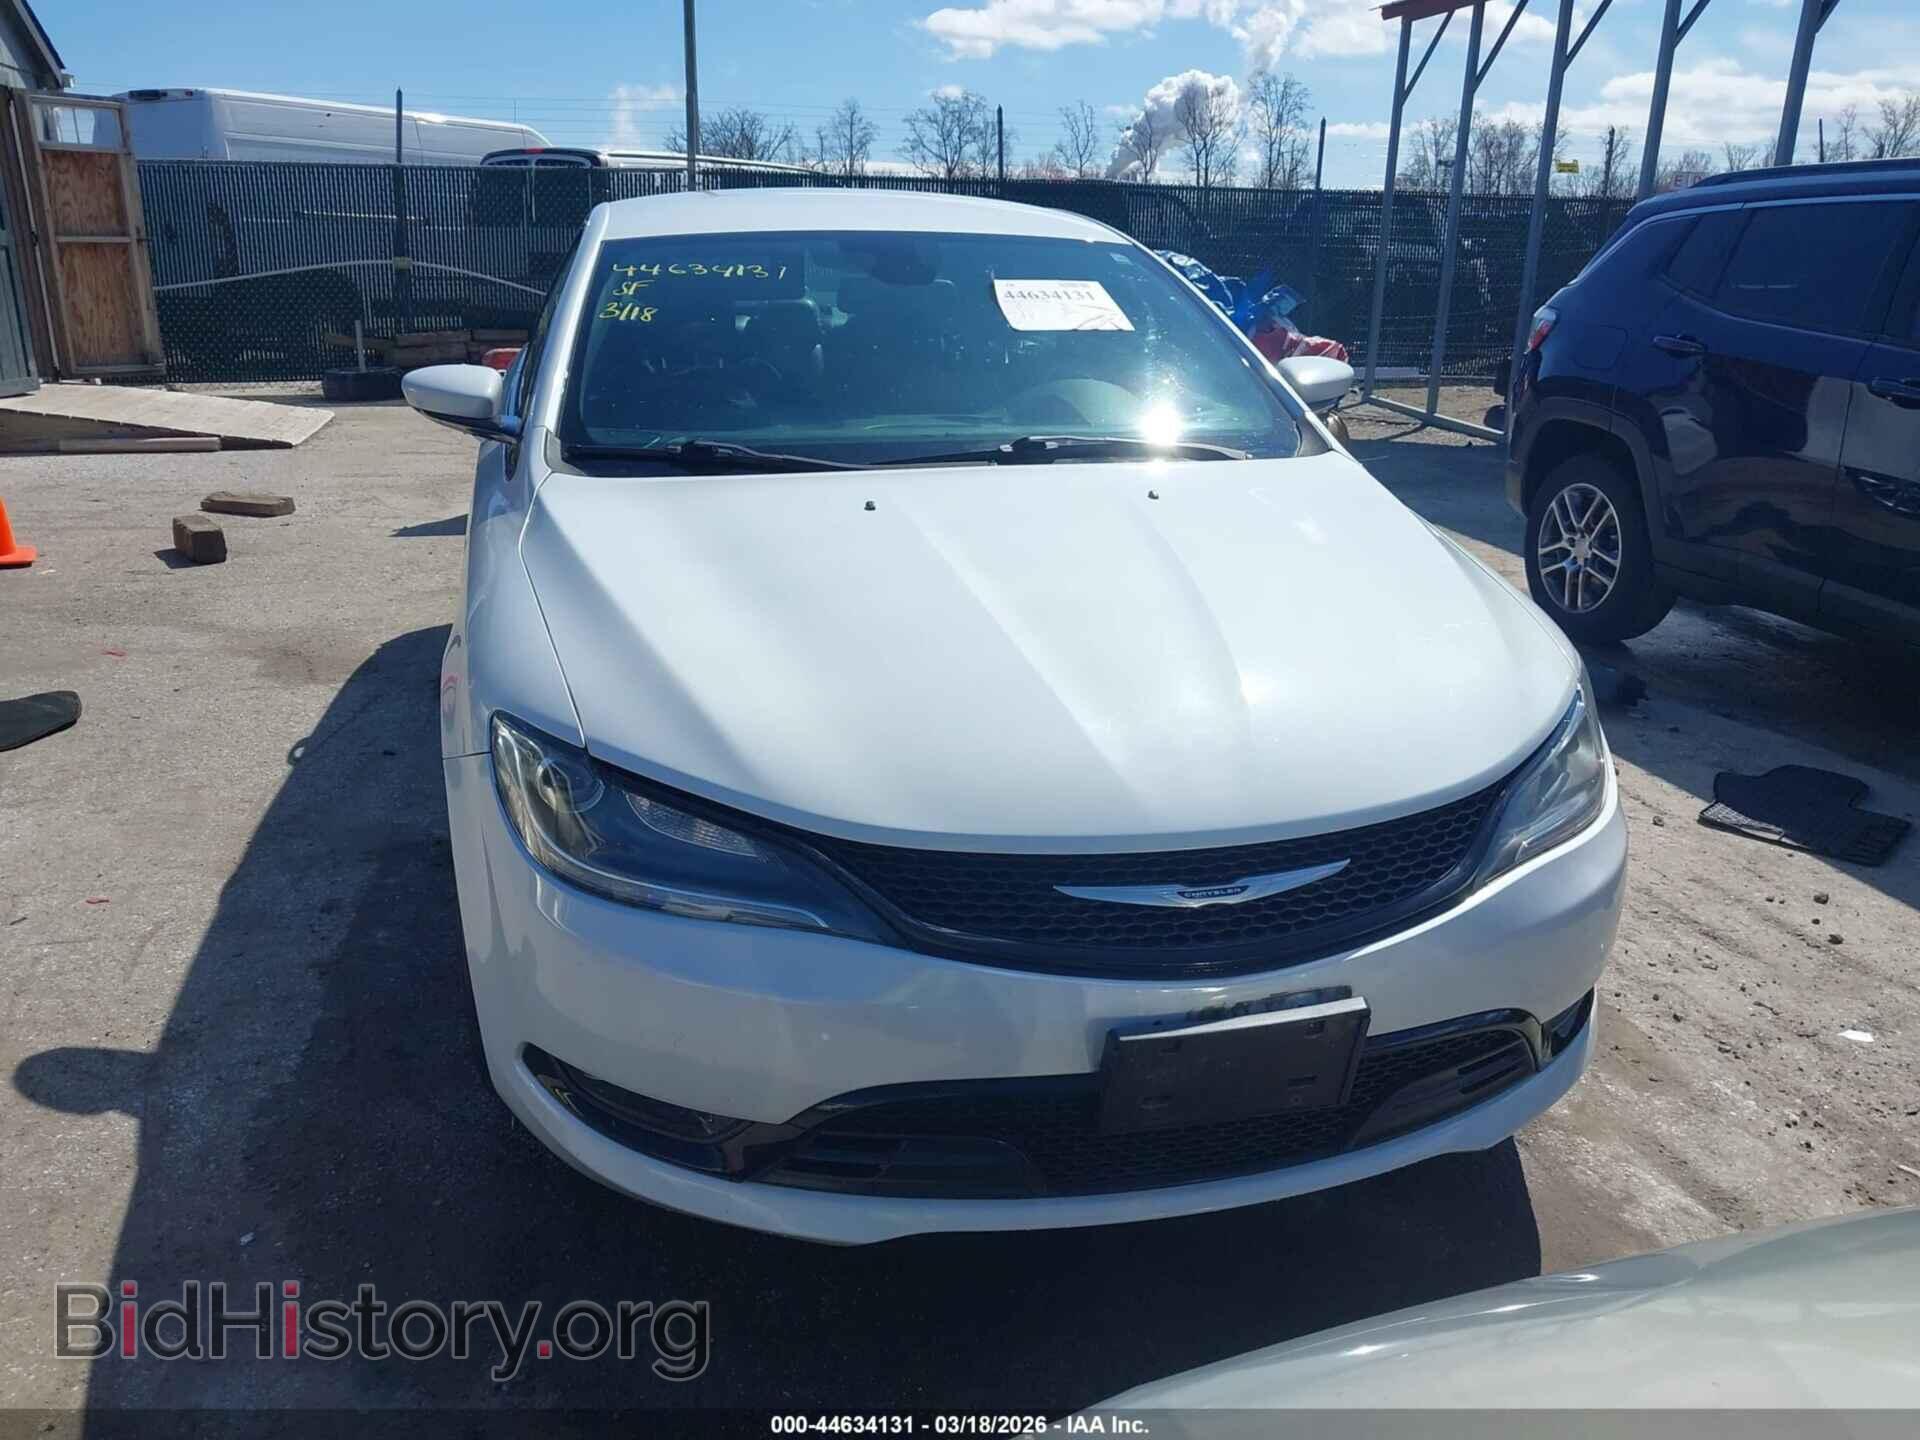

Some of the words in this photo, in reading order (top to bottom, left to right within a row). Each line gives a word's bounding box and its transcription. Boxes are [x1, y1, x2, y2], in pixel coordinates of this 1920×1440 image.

[612, 263, 787, 280] 44634131
[612, 280, 655, 296] SF
[1003, 289, 1096, 301] 44634131
[599, 302, 659, 322] 3/18
